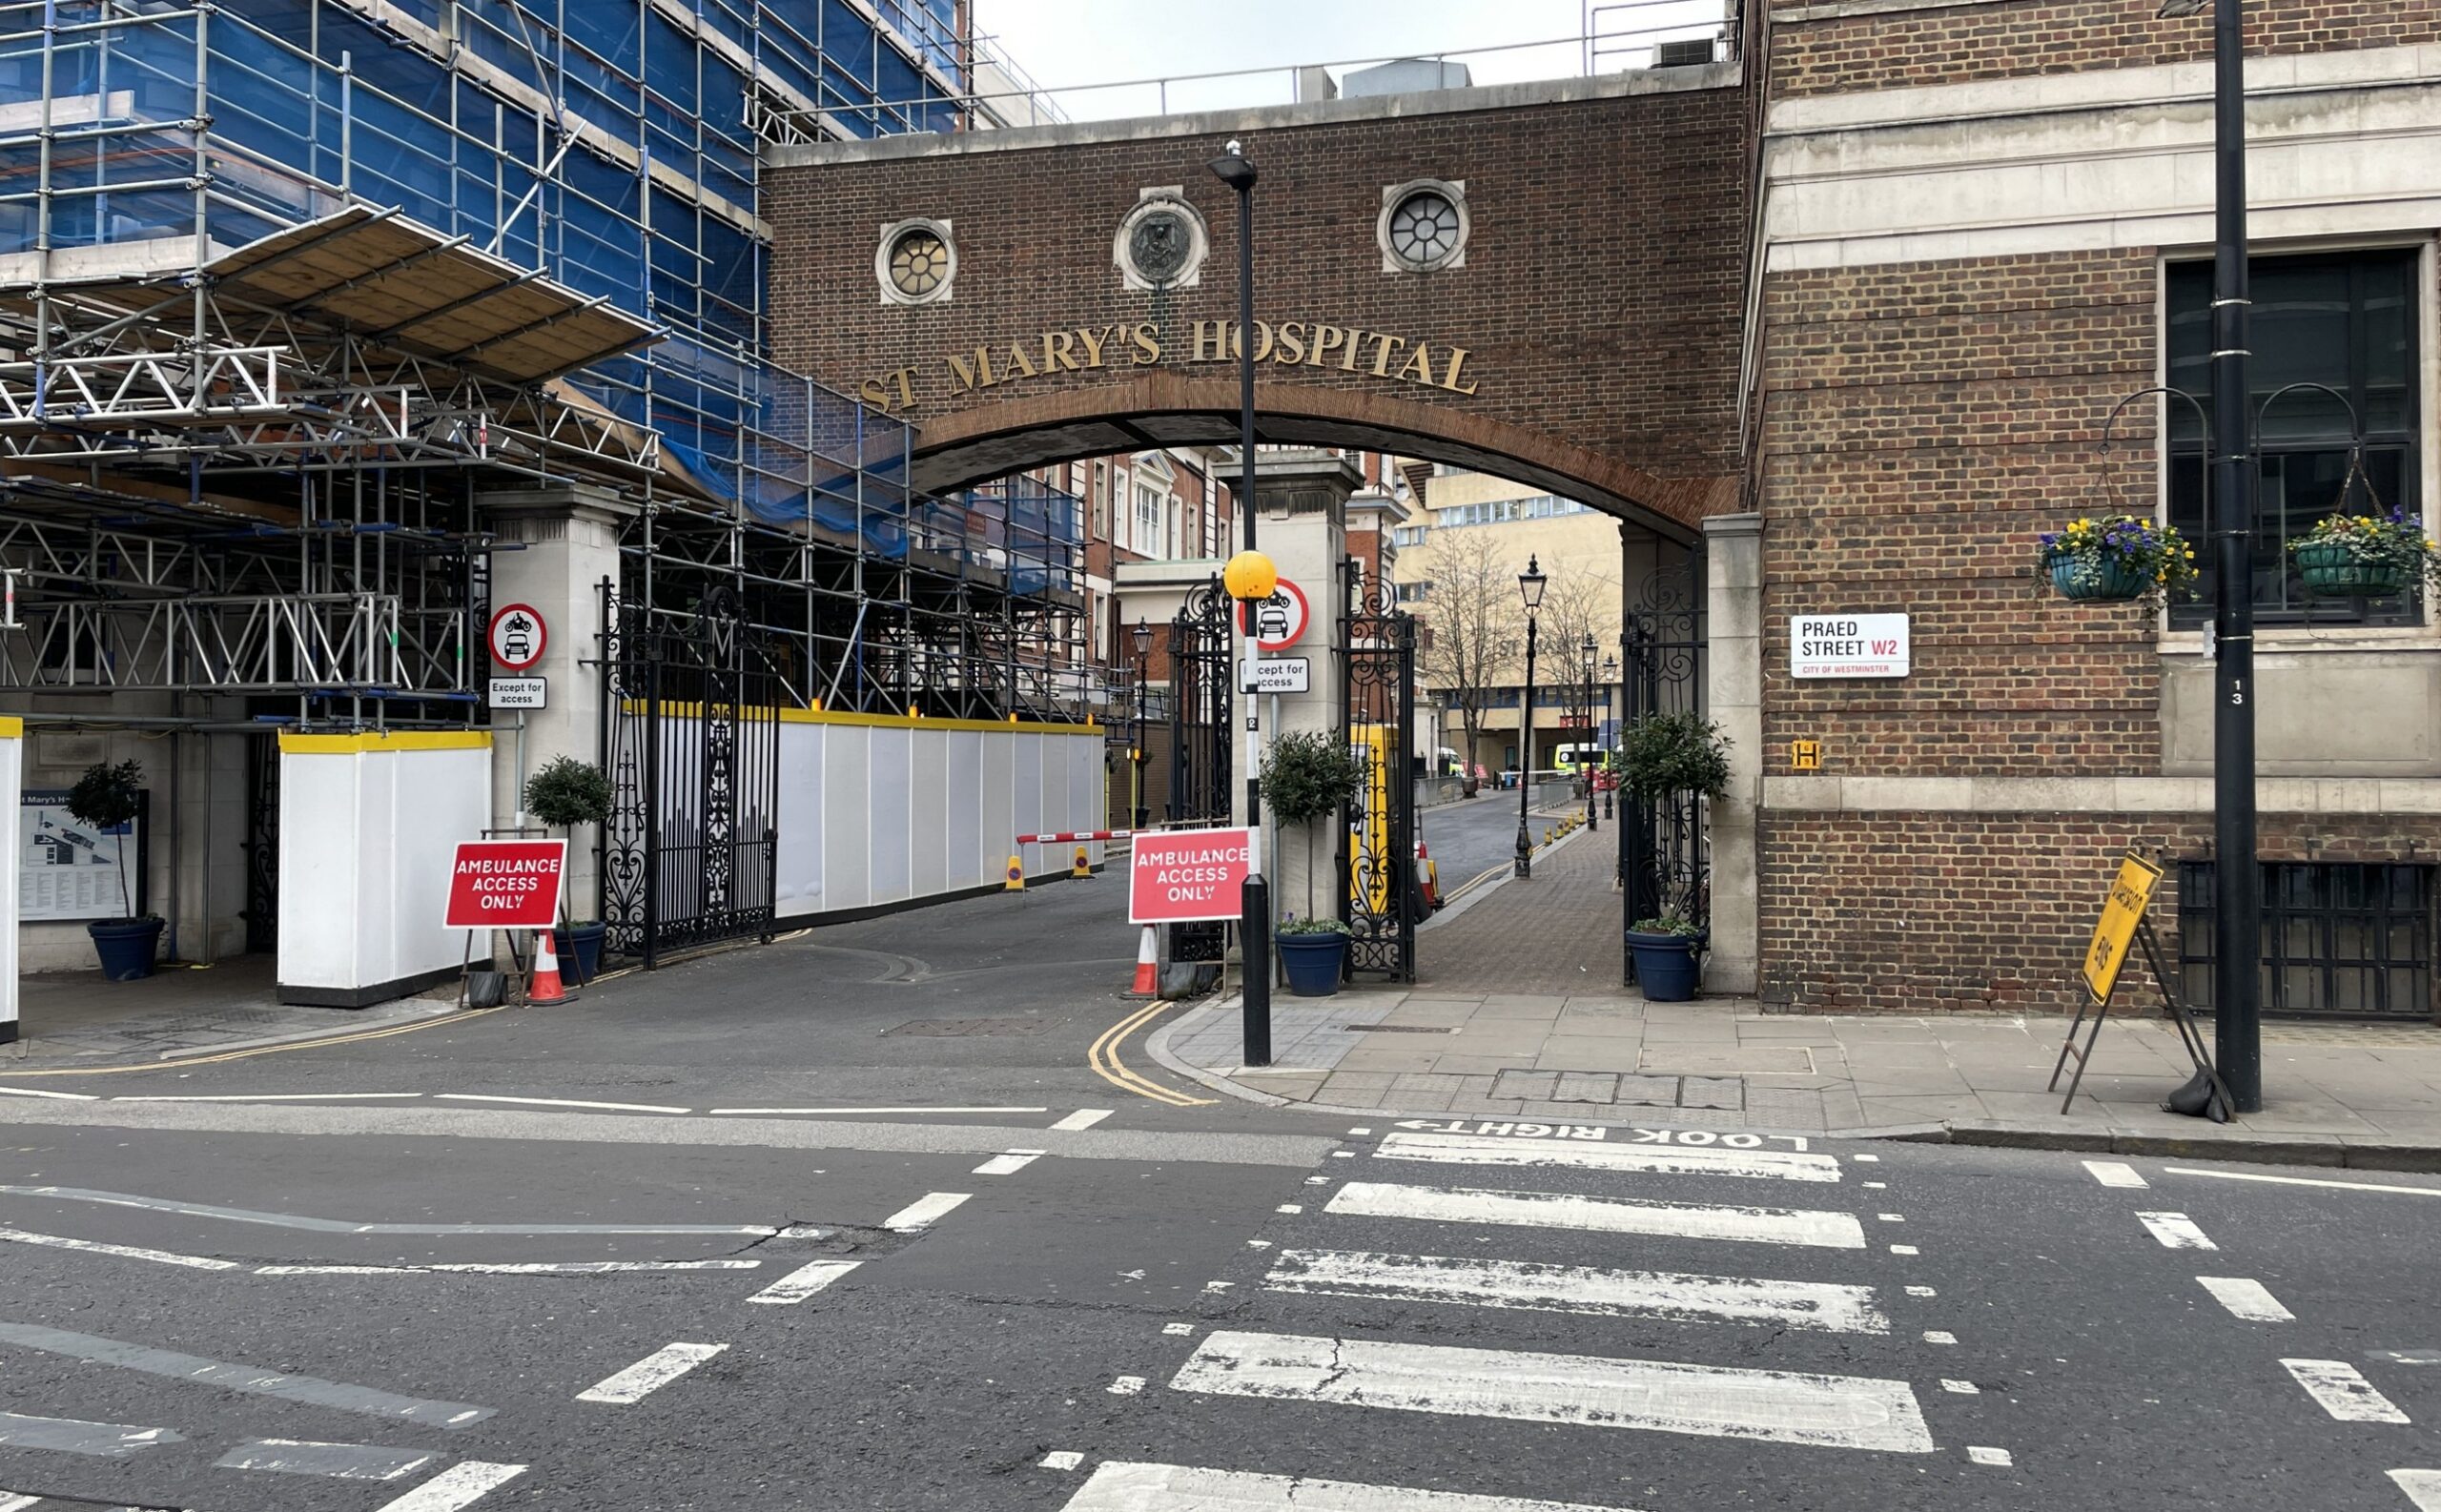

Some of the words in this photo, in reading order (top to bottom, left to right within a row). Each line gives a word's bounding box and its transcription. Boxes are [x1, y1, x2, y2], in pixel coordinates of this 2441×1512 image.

[859, 365, 919, 418] ST
[944, 321, 1160, 396] MARY'S
[1190, 319, 1479, 396] HOSPITAL
[1802, 622, 1857, 637] PRAED
[1802, 641, 1865, 656] STREET
[1871, 640, 1897, 655] W2
[1244, 664, 1283, 676] cept
[1287, 664, 1303, 674] for
[492, 683, 524, 693] Except
[528, 683, 542, 692] for
[1259, 679, 1293, 687] ccess
[1248, 718, 1256, 728] 2
[1796, 743, 1816, 766] H
[28, 796, 56, 805] Mary's
[1138, 848, 1249, 868] AMBULANCE
[456, 859, 560, 874] AMBULANCE
[1157, 867, 1228, 884] ACCESS
[472, 877, 538, 891] ACCESS
[481, 894, 524, 909] ONLY
[1168, 886, 1215, 902] ONLY
[1432, 1120, 1607, 1140] RIGHT
[1631, 1129, 1808, 1152] LOOK
